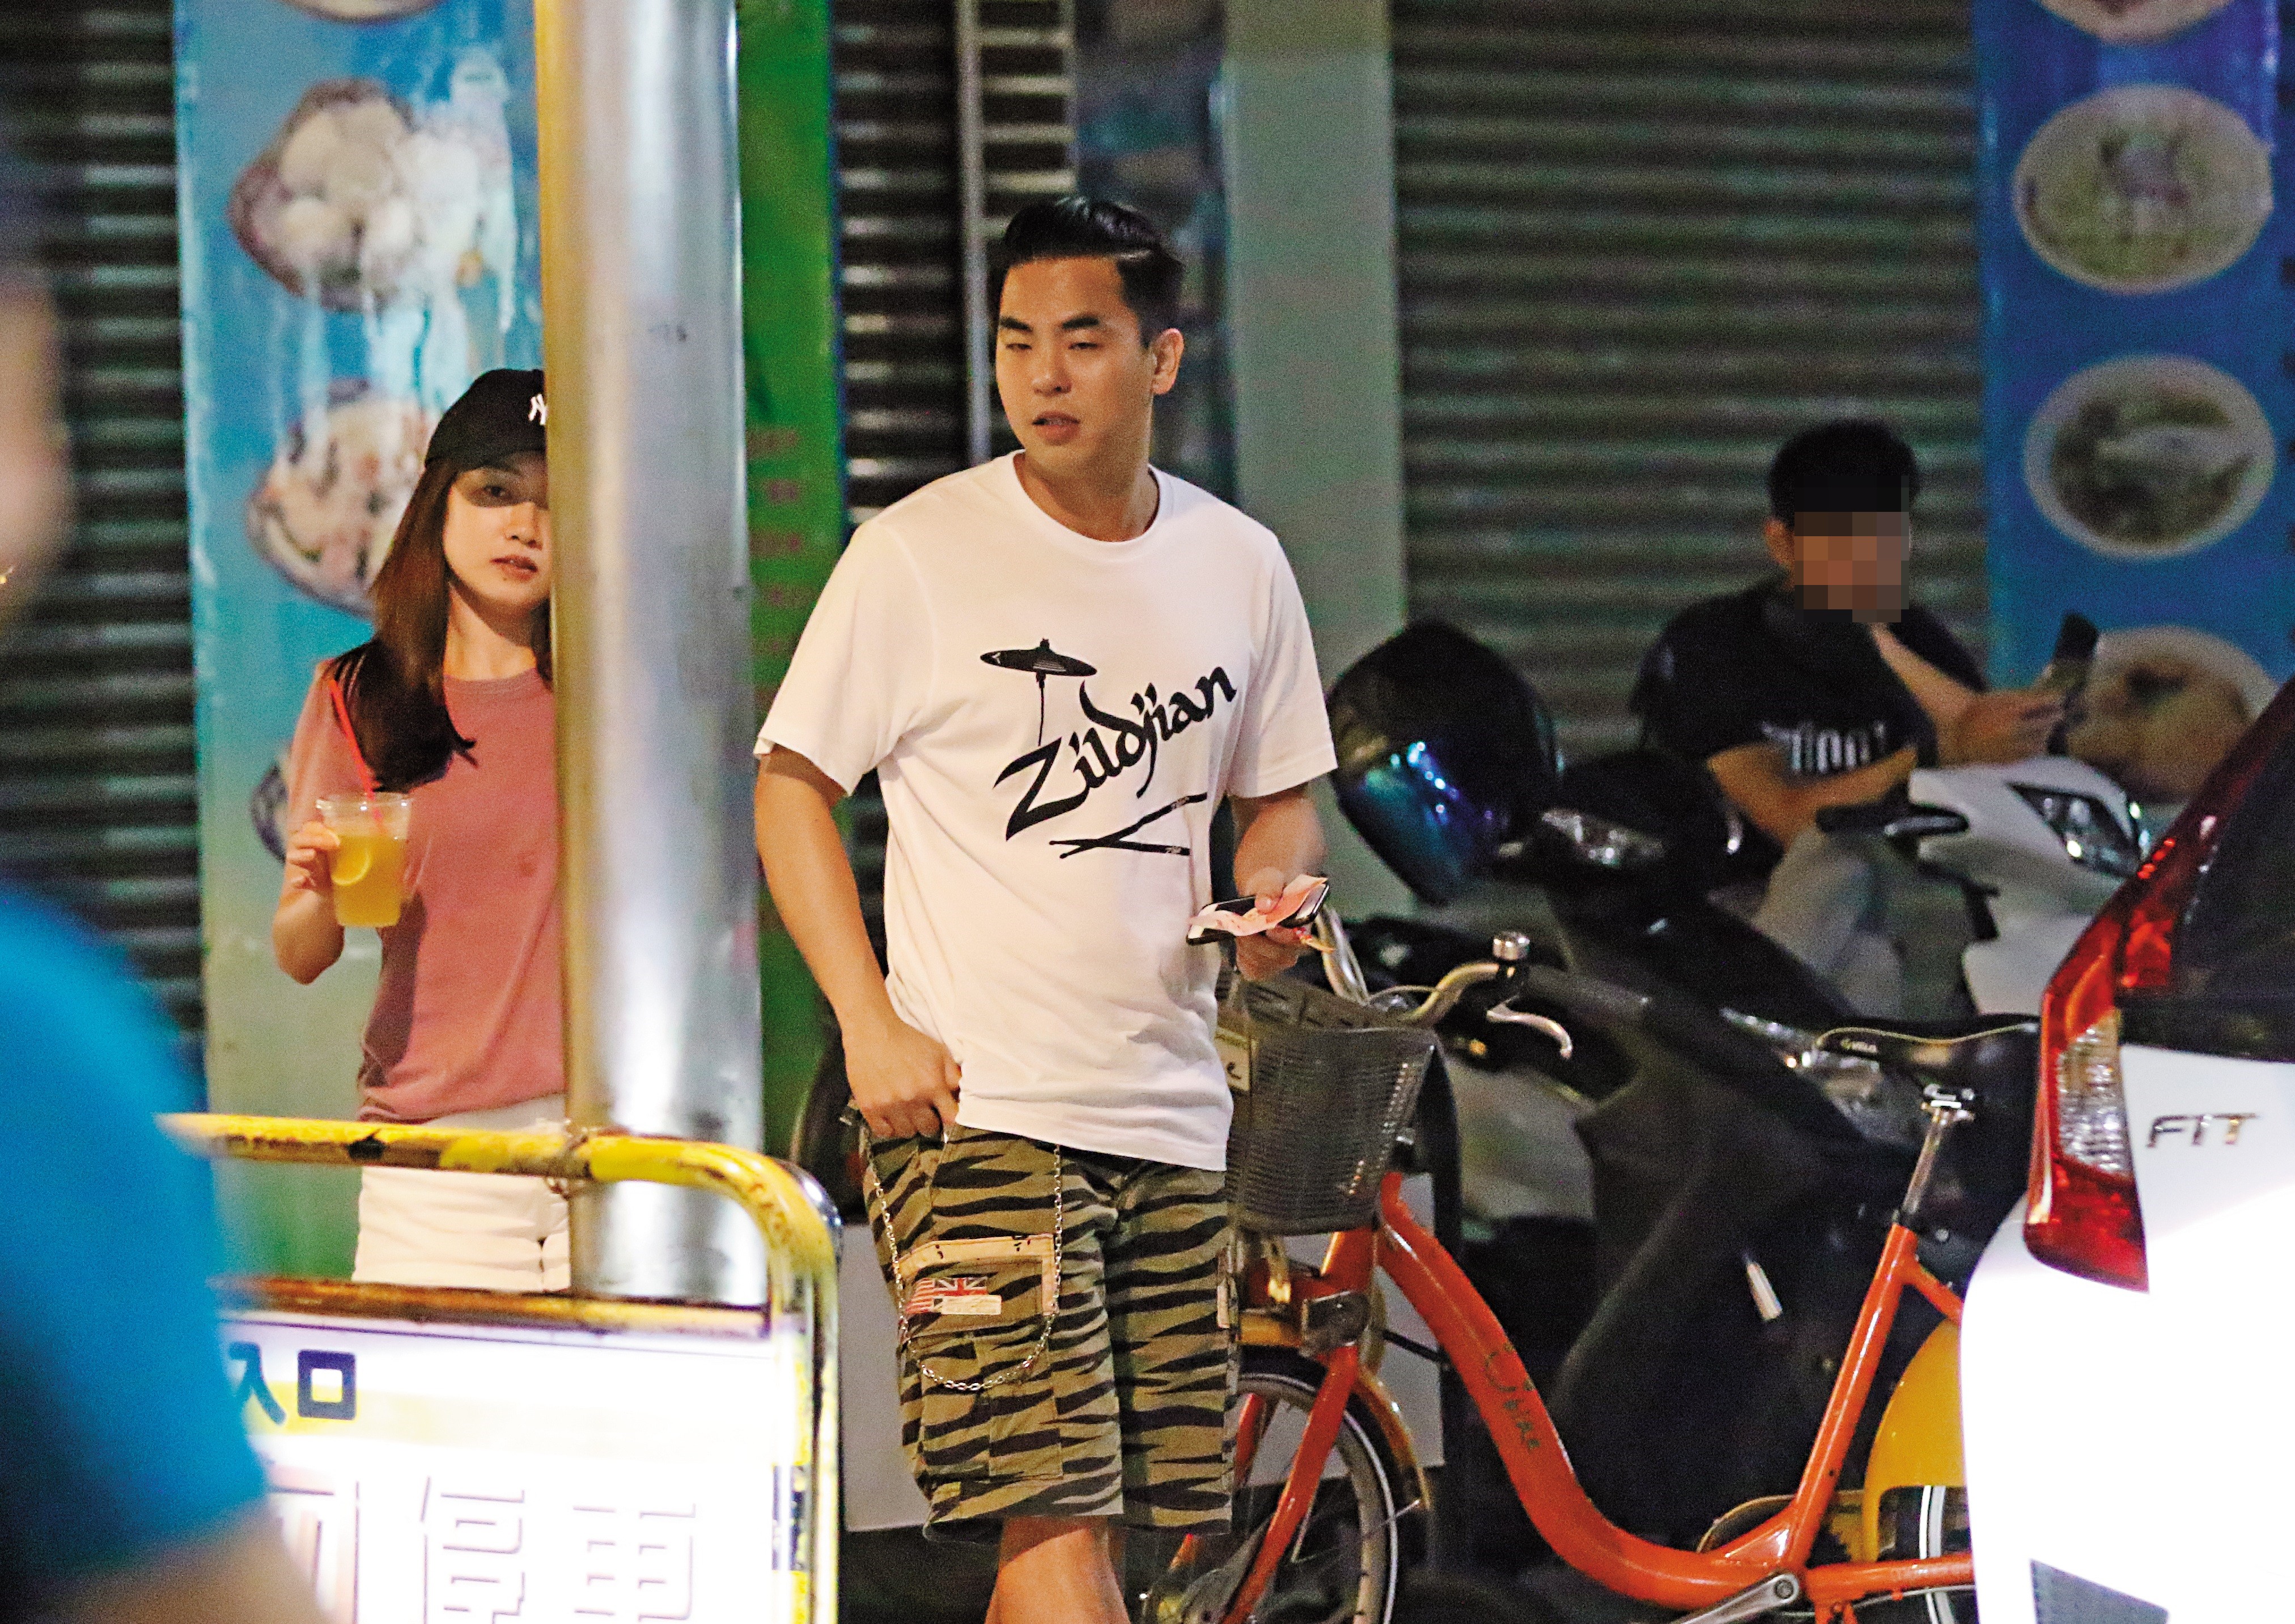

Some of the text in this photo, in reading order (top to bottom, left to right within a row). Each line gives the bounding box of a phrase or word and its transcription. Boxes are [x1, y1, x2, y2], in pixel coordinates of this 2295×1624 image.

[992, 666, 1237, 842] Zildjian
[2147, 1113, 2260, 1148] FIT
[228, 1341, 357, 1422] 入口
